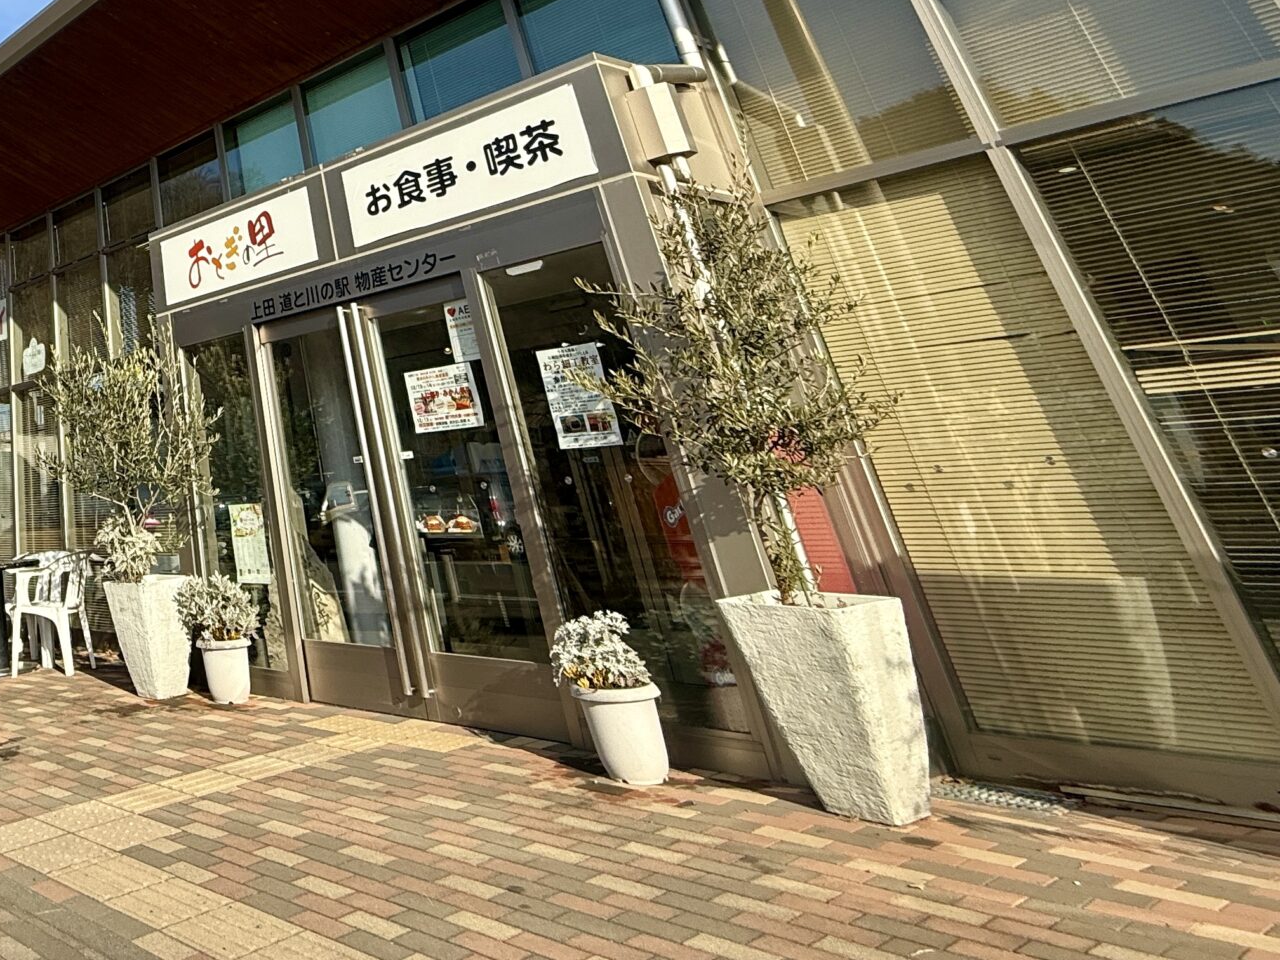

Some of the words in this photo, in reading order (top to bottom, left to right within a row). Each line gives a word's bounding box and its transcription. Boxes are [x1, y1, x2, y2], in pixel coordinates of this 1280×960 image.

[365, 119, 563, 216] お食事・喫茶
[187, 210, 284, 289] おとぎの里
[251, 297, 276, 321] 上田
[279, 275, 351, 313] 道と川の駅
[354, 252, 456, 294] 物産センター
[458, 304, 470, 315] AE
